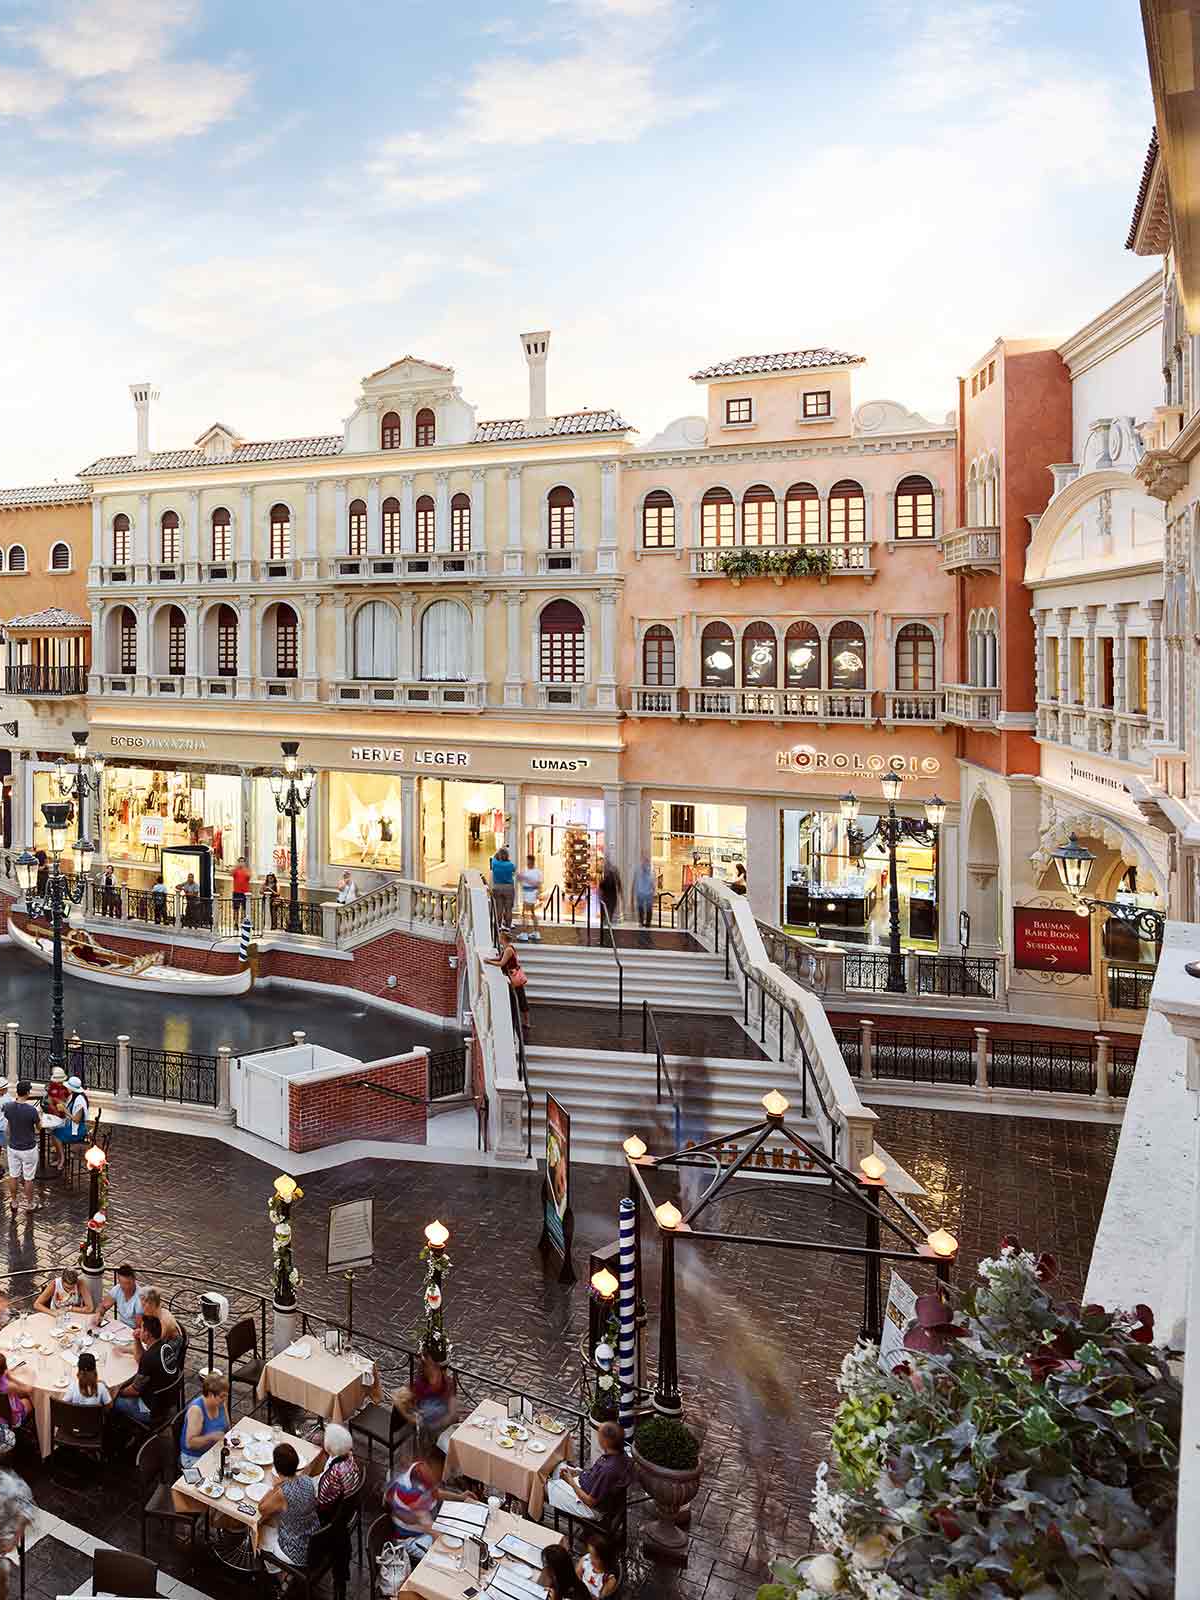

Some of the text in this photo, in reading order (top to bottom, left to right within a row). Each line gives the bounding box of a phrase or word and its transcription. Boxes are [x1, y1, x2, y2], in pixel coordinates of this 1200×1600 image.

[351, 748, 468, 766] HERVE LEGER
[776, 749, 940, 774] HOROLOGIO
[532, 759, 577, 771] LUMAS
[1033, 921, 1070, 931] BAUMAN
[1025, 928, 1080, 940] RARE BOOKS
